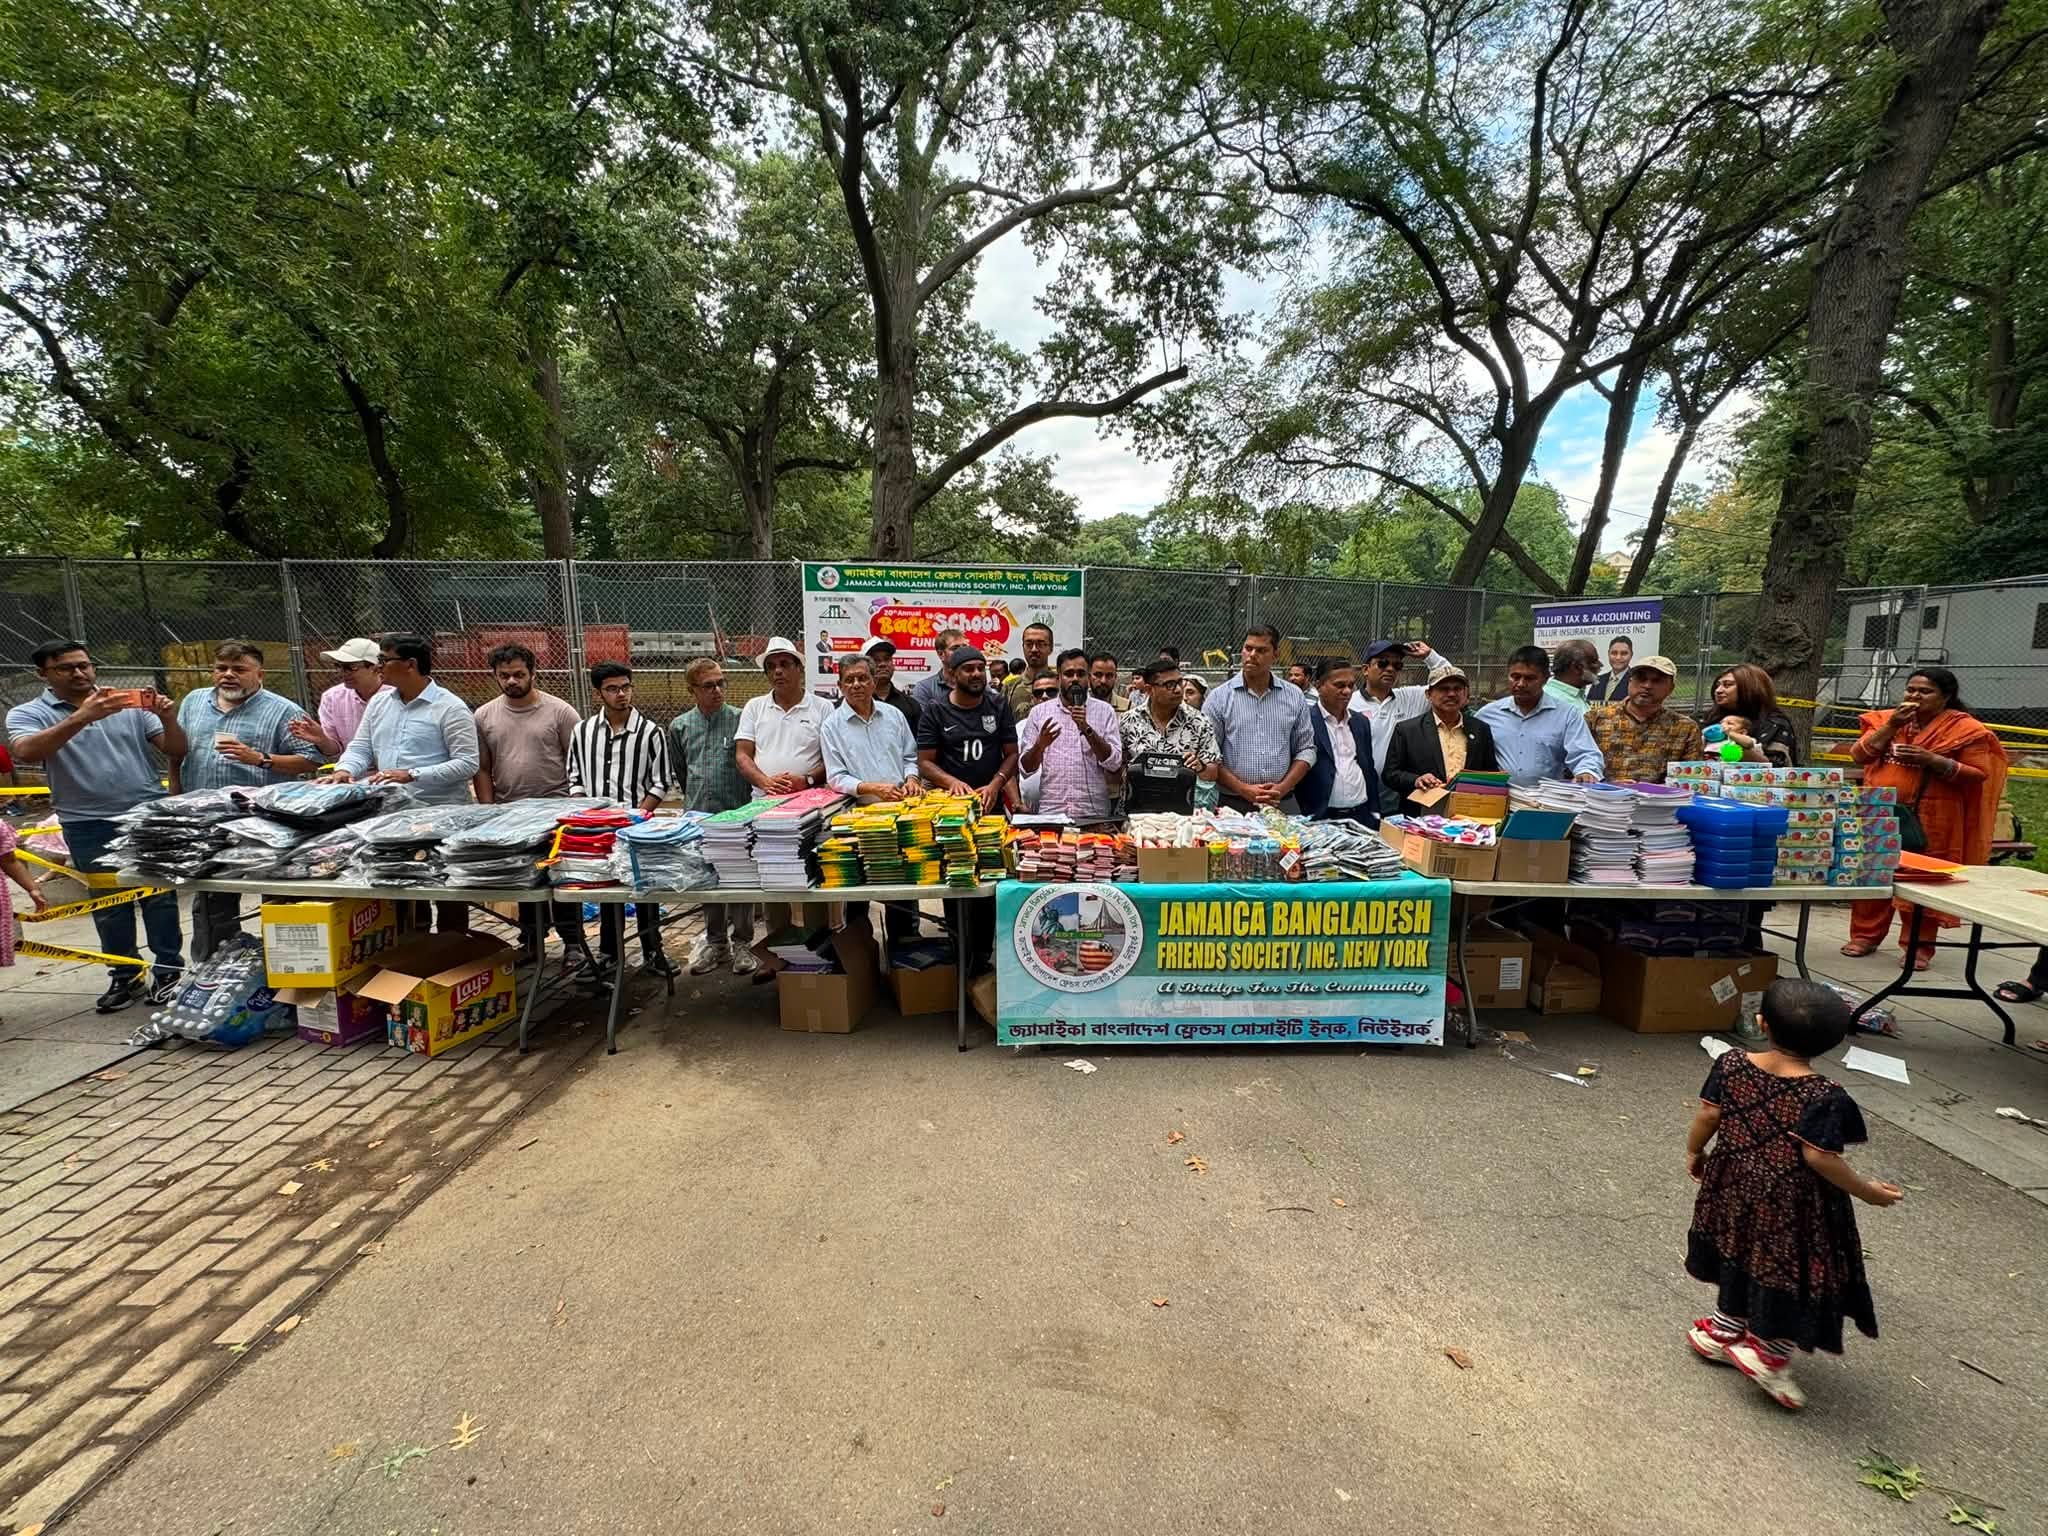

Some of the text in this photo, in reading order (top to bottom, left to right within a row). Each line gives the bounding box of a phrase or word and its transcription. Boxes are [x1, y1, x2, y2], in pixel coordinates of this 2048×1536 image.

[884, 581, 937, 589] BANGLADESH
[939, 582, 971, 590] FRIENDS
[973, 582, 1008, 590] SOCIETY,
[1536, 610, 1651, 625] ZILLUR TAX & ACCOUNTING
[1537, 625, 1646, 638] ZILLUR INSURANCE SERVICES INC
[963, 738, 983, 761] 10
[1158, 899, 1431, 937] JAMAICA BANGLADESH
[1157, 941, 1227, 970] FRIENDS
[1230, 941, 1303, 972] SOCIETY,
[1305, 941, 1339, 969] INC.
[1342, 940, 1381, 969] NEW
[1383, 939, 1429, 968] YORK
[1157, 981, 1430, 996] A Bridge For The Community
[1009, 1020, 1086, 1037] জ্যামাইকা
[1092, 1023, 1169, 1037] বাংলাদেশ
[1175, 1023, 1225, 1039] ফ্রেন্ডস
[1231, 1019, 1303, 1036] সোসাইটি
[1358, 1017, 1434, 1037] নিউইয়র্ক
